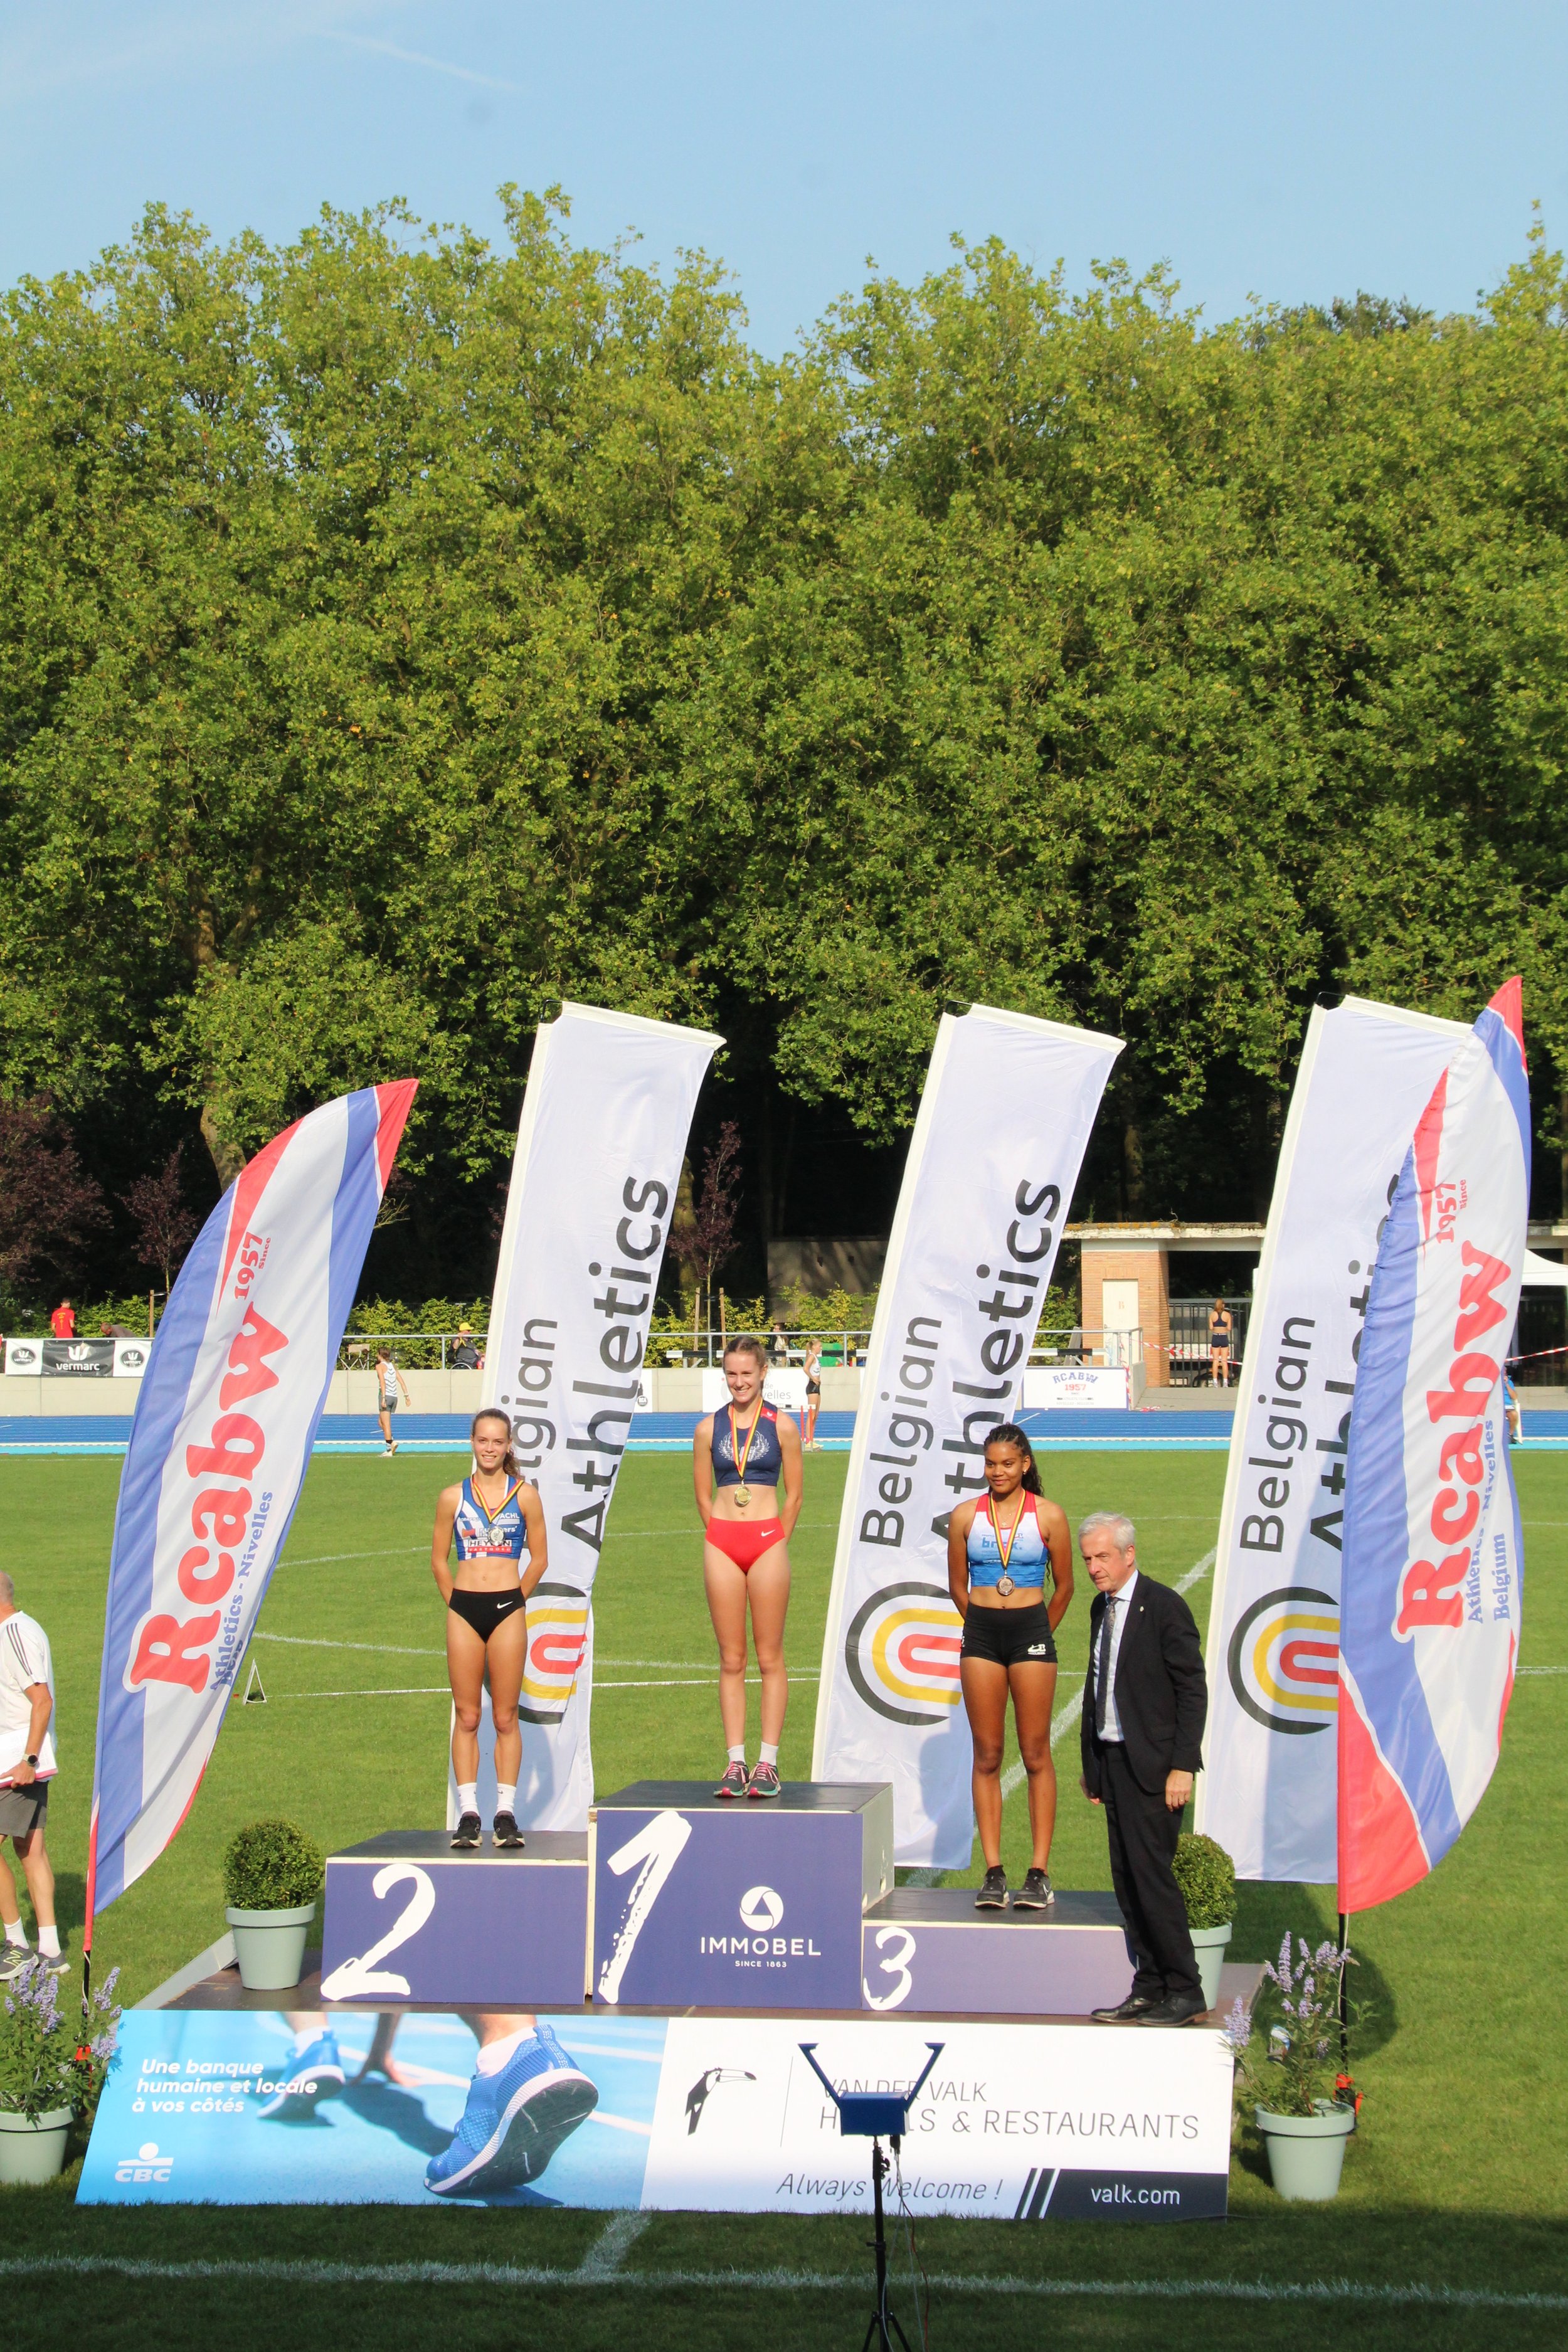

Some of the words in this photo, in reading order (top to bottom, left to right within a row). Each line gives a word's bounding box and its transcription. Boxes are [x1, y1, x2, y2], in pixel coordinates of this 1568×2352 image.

[1435, 1183, 1456, 1244] 1957
[235, 1231, 263, 1300] 1957
[258, 1237, 271, 1269] Since
[56, 1363, 100, 1371] vermarc
[561, 1176, 668, 1552] Athletics
[930, 1179, 1061, 1541] thletics
[1052, 1372, 1099, 1384] RCABW
[501, 1318, 558, 1493] gian
[860, 1316, 943, 1547] Belgian
[1239, 1316, 1316, 1552] Belgian
[1397, 1240, 1512, 1634] Rcabw
[129, 1300, 290, 1695] Rcabw
[1483, 1419, 1495, 1512] Nivelles
[210, 1594, 243, 1690] Athletics
[238, 1491, 273, 1577] Nivelles
[1493, 1533, 1511, 1621] Belgium
[320, 1863, 436, 2001] 2
[597, 1810, 694, 2005] 1
[700, 1936, 822, 1956] IMMOBEL
[863, 1926, 916, 2011] 3
[136, 2079, 225, 2094] humaine
[230, 2080, 251, 2094] et
[256, 2079, 318, 2094] locale
[142, 2059, 181, 2074] Une
[186, 2059, 264, 2077] banque
[824, 2079, 869, 2099] VAN
[929, 2081, 987, 2102] VALK
[132, 2097, 146, 2112] à
[151, 2101, 185, 2112] vos
[190, 2097, 245, 2113] côtés
[952, 2112, 971, 2133] &
[984, 2110, 1199, 2140] RESTAURANTS
[115, 2169, 171, 2182] CBC
[776, 2173, 867, 2201] Always
[881, 2176, 987, 2200] Welcome
[994, 2179, 1004, 2201] !
[1091, 2185, 1181, 2205] valk.com
